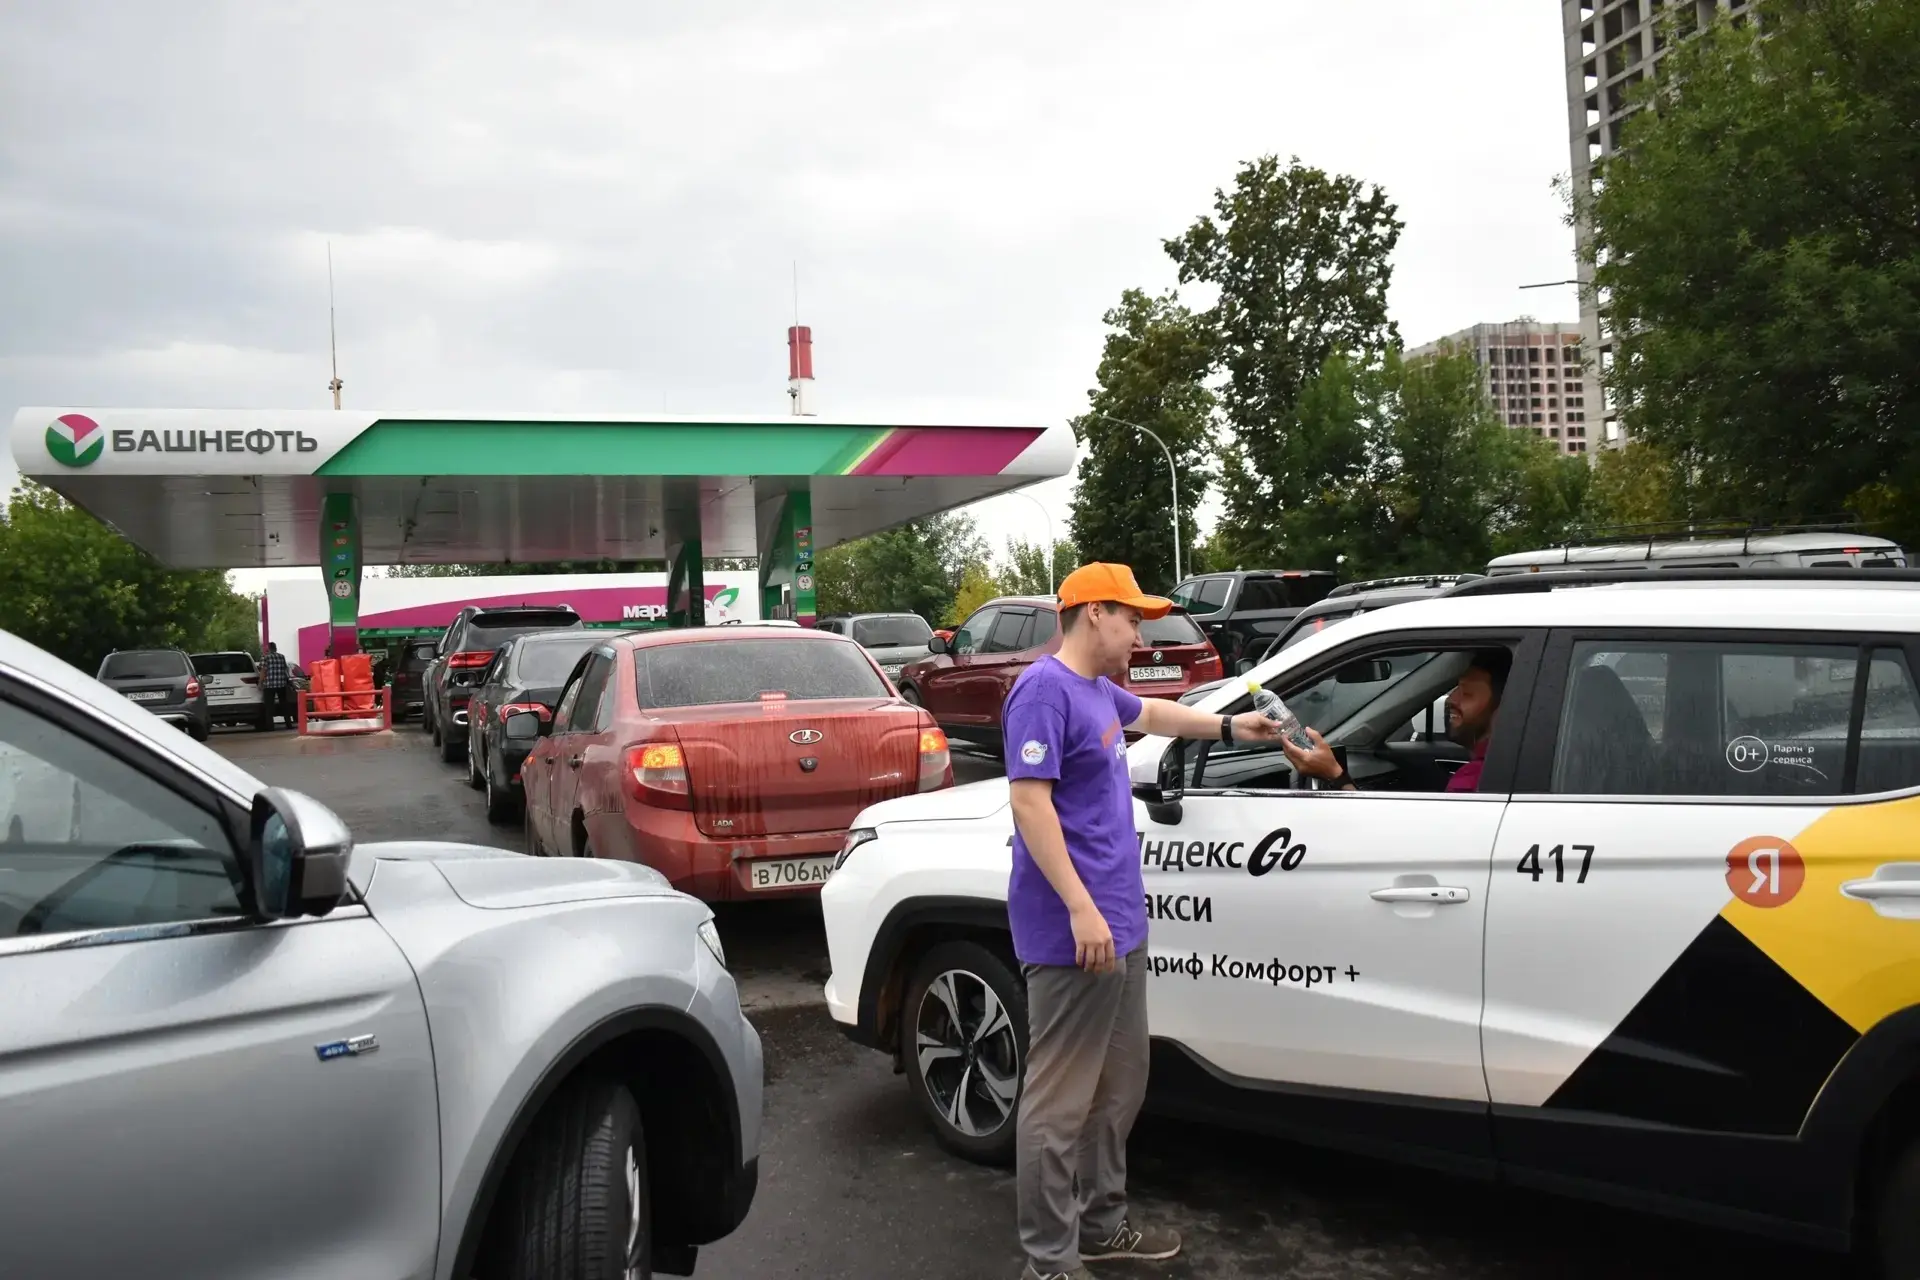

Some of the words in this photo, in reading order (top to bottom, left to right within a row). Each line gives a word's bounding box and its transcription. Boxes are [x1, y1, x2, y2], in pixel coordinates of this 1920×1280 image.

[112, 428, 318, 454] БАШНЕФТЬ
[1734, 745, 1759, 762] 0+
[1773, 744, 1815, 753] Партнр
[1773, 756, 1812, 764] сервиса
[712, 819, 734, 827] LADA
[1247, 827, 1307, 877] Go
[1516, 843, 1595, 884] 417
[1144, 893, 1213, 923] акси
[1211, 953, 1337, 988] Комфорт
